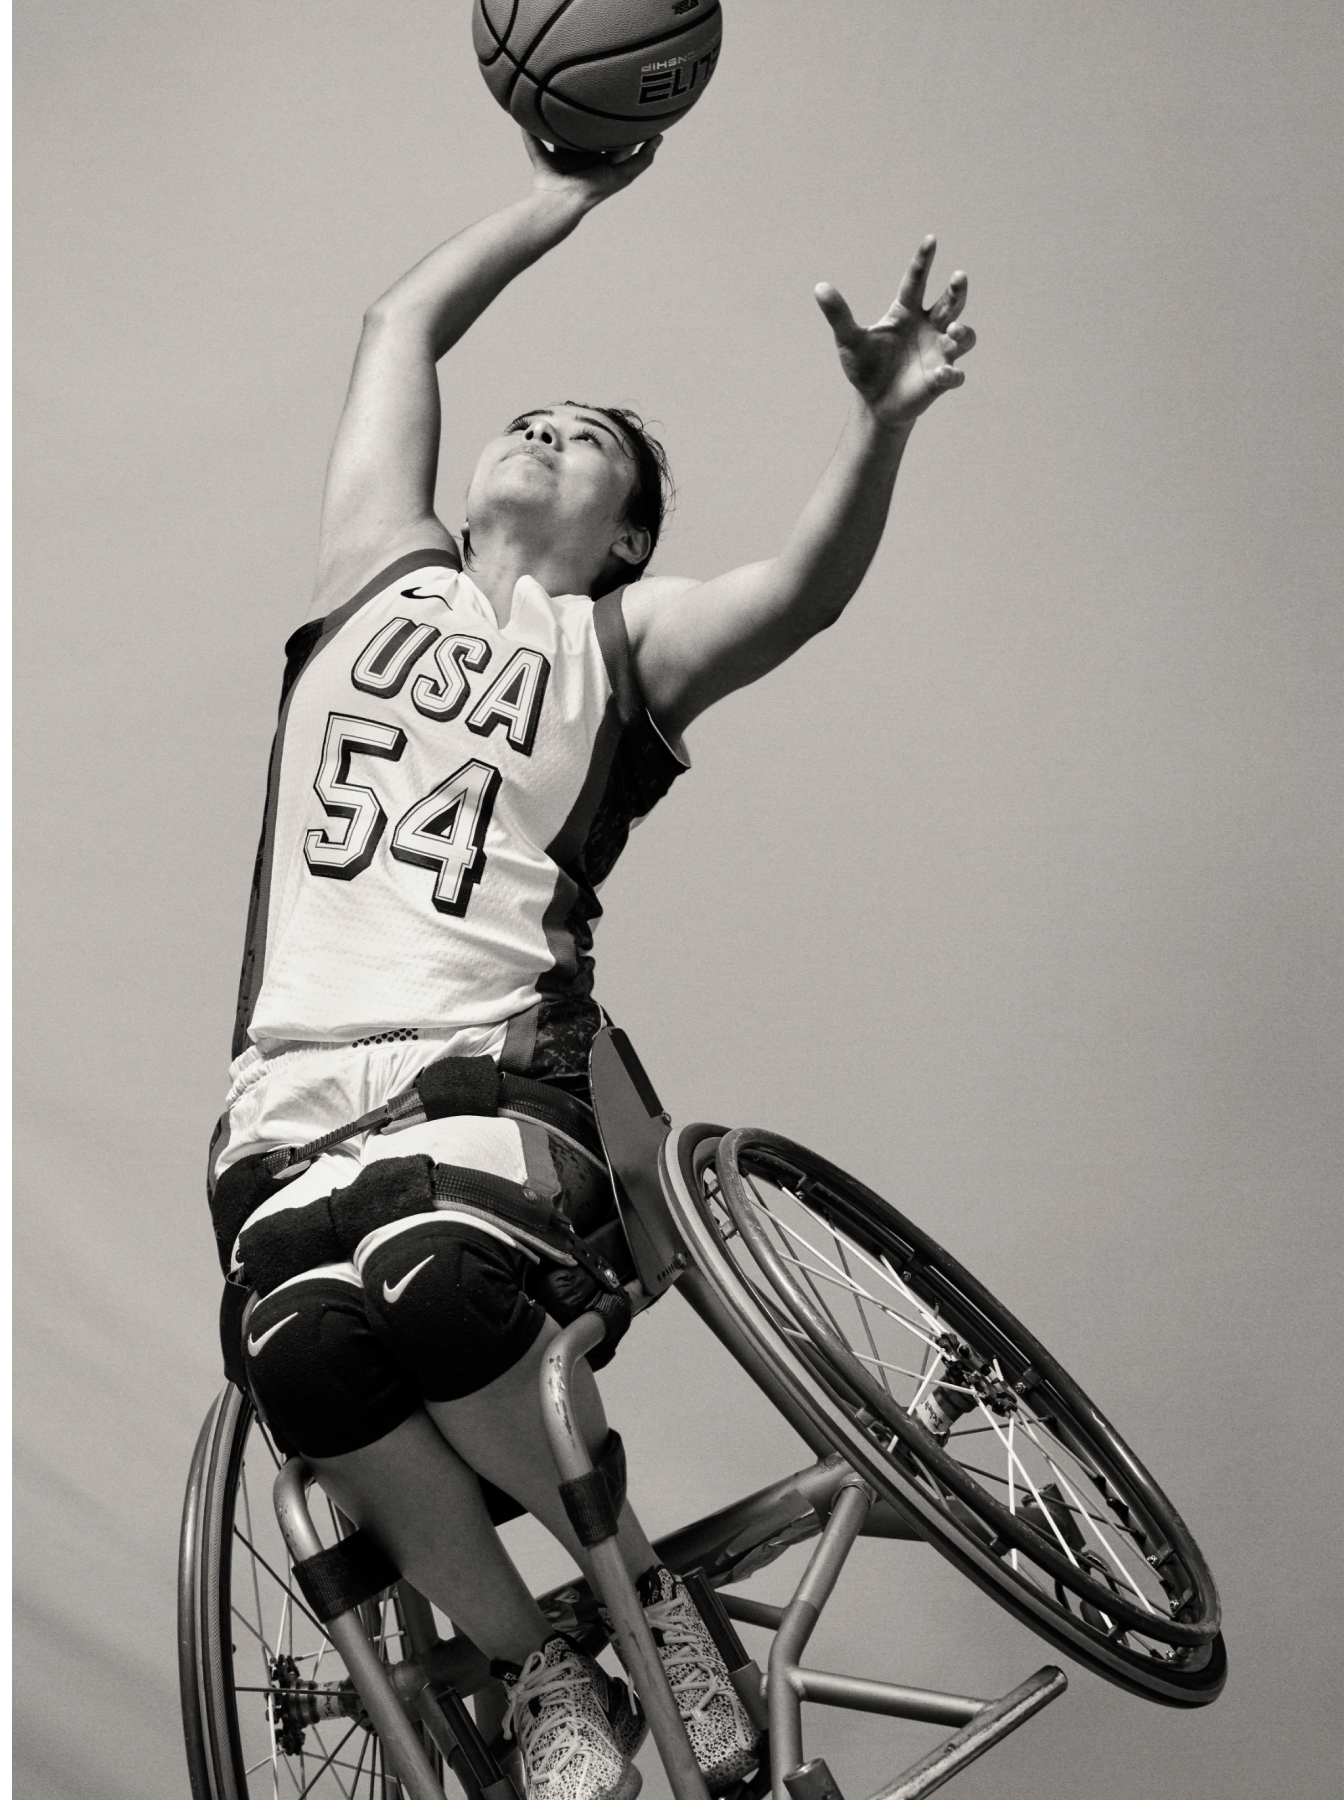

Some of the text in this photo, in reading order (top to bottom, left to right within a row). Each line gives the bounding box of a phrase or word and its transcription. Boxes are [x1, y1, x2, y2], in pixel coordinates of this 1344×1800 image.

[637, 43, 720, 105] ELITE
[351, 617, 551, 757] USA
[303, 711, 503, 917] 54
